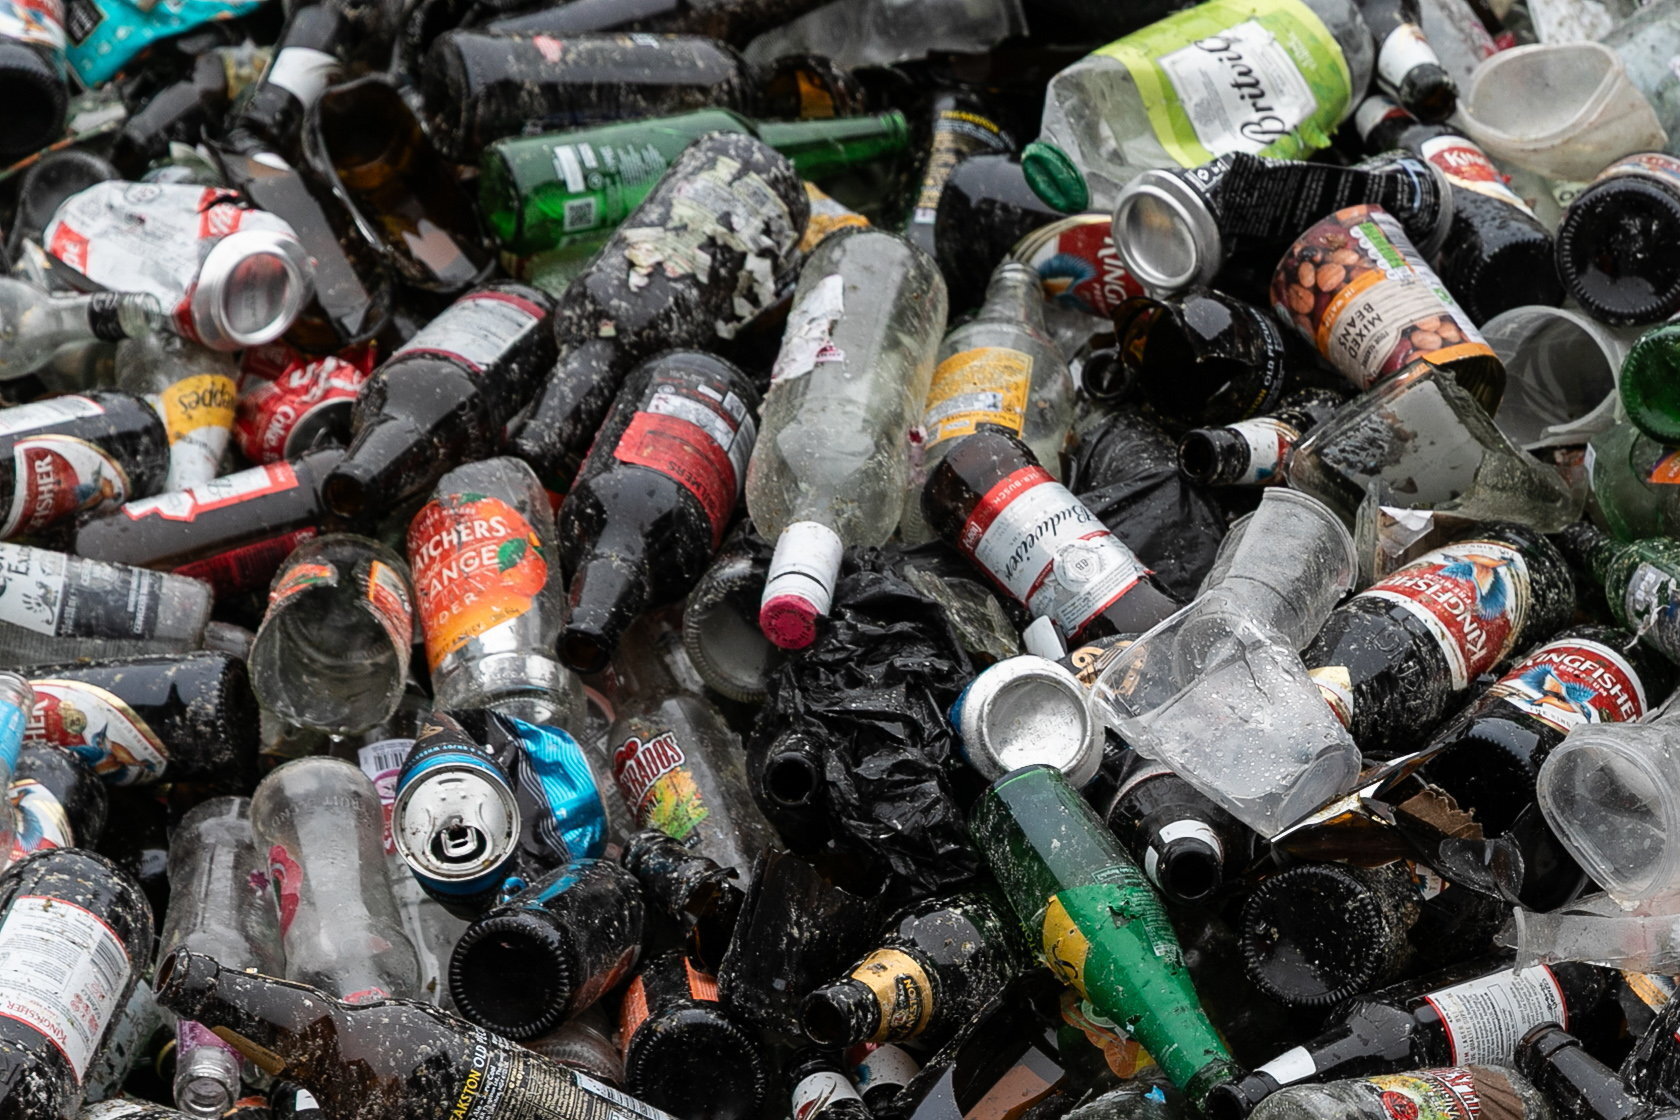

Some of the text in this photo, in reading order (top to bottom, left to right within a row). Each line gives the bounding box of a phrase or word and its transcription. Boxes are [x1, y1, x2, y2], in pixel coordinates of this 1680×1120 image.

[1195, 36, 1289, 144] Britvic
[1338, 301, 1374, 352] BEANS
[1346, 311, 1384, 361] MIXED
[416, 516, 507, 572] ATCHERS
[1003, 502, 1100, 582] Budweiser
[429, 553, 499, 601] ANGE
[1380, 572, 1488, 667] KINGFISH
[474, 1041, 489, 1069] OLD
